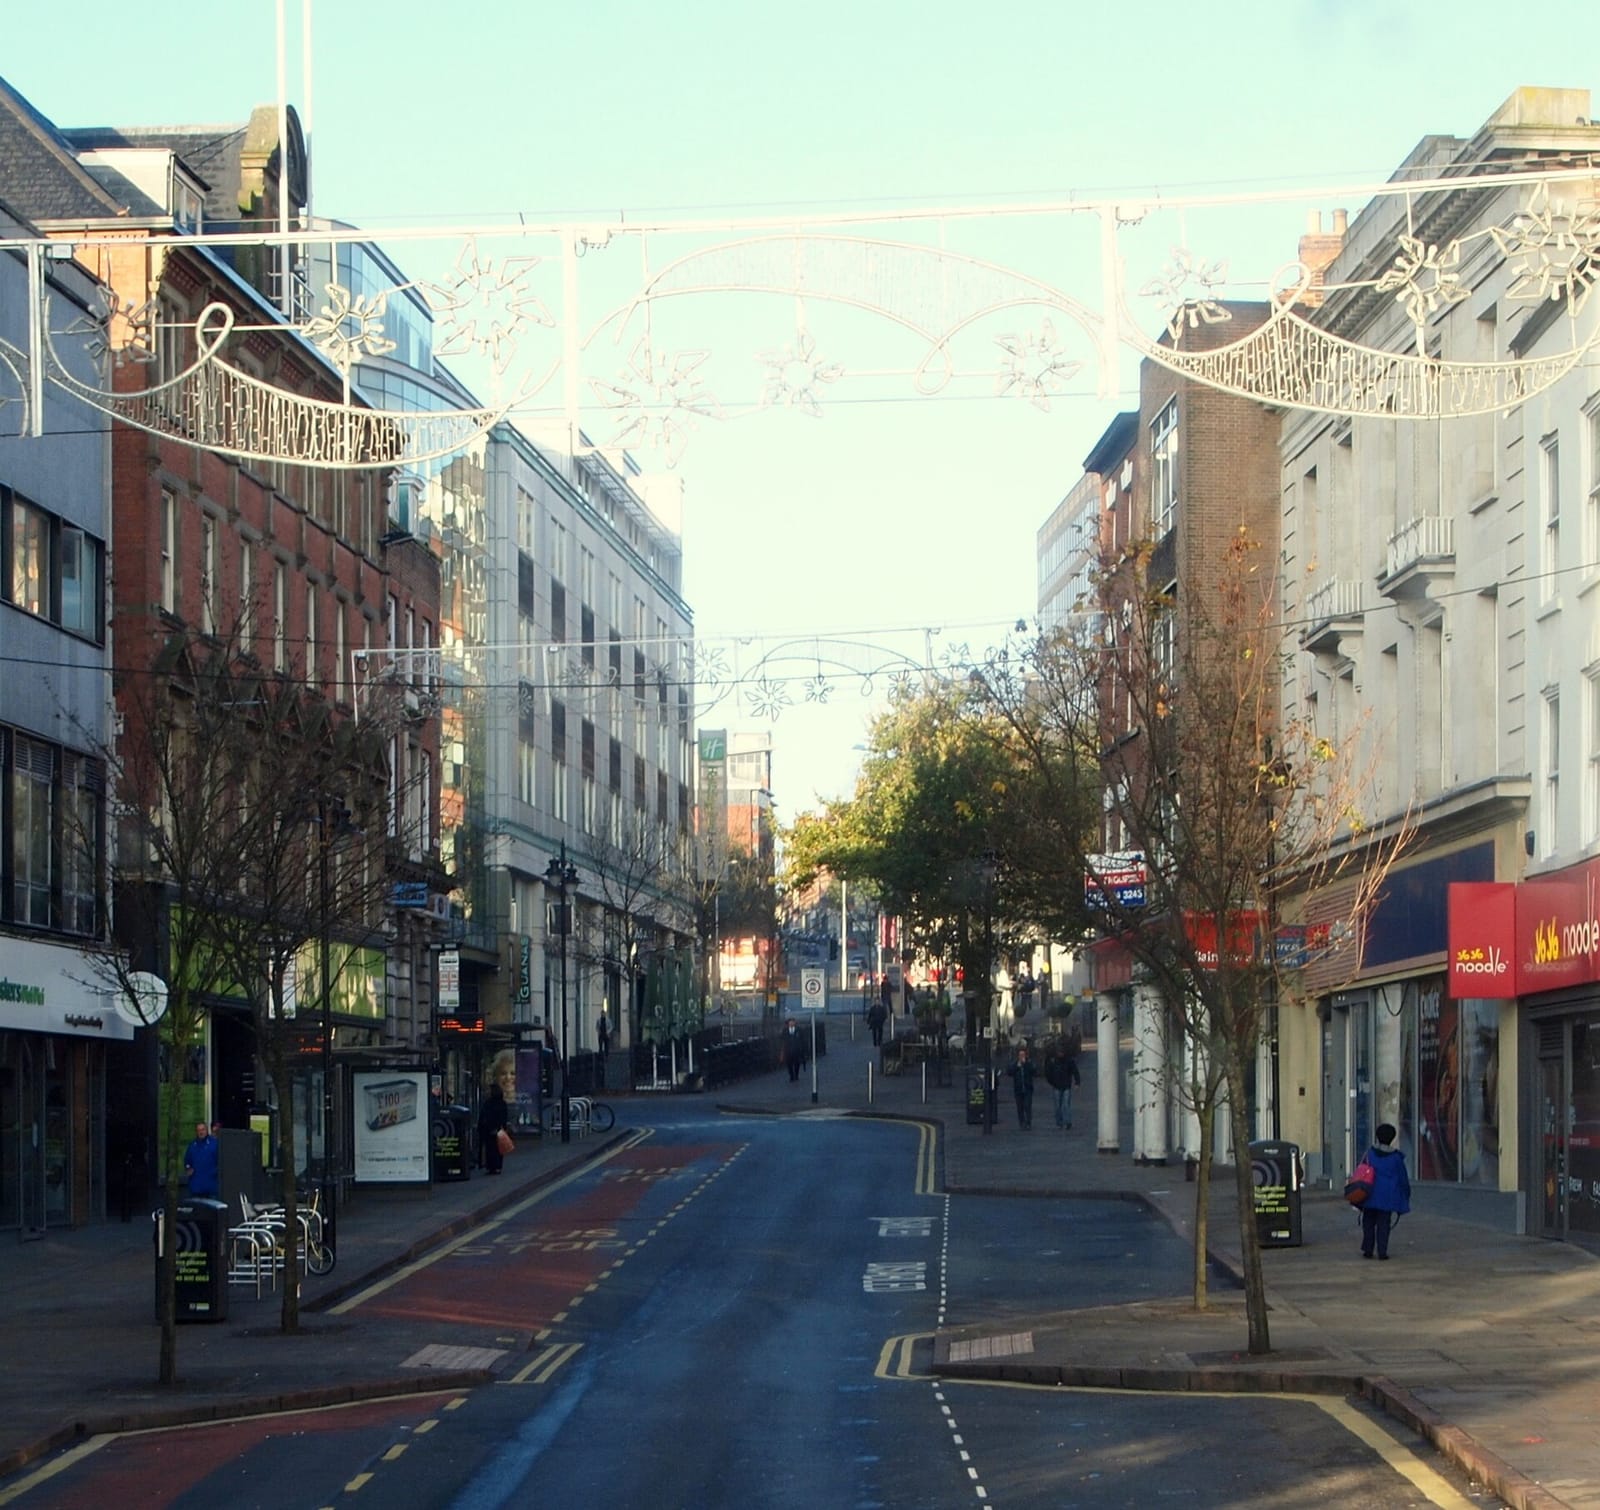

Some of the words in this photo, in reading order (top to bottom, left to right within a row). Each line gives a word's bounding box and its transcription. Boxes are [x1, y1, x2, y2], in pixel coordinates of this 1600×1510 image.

[1456, 945, 1507, 976] noodle
[494, 1228, 619, 1242] BUS
[452, 1240, 628, 1256] STOP
